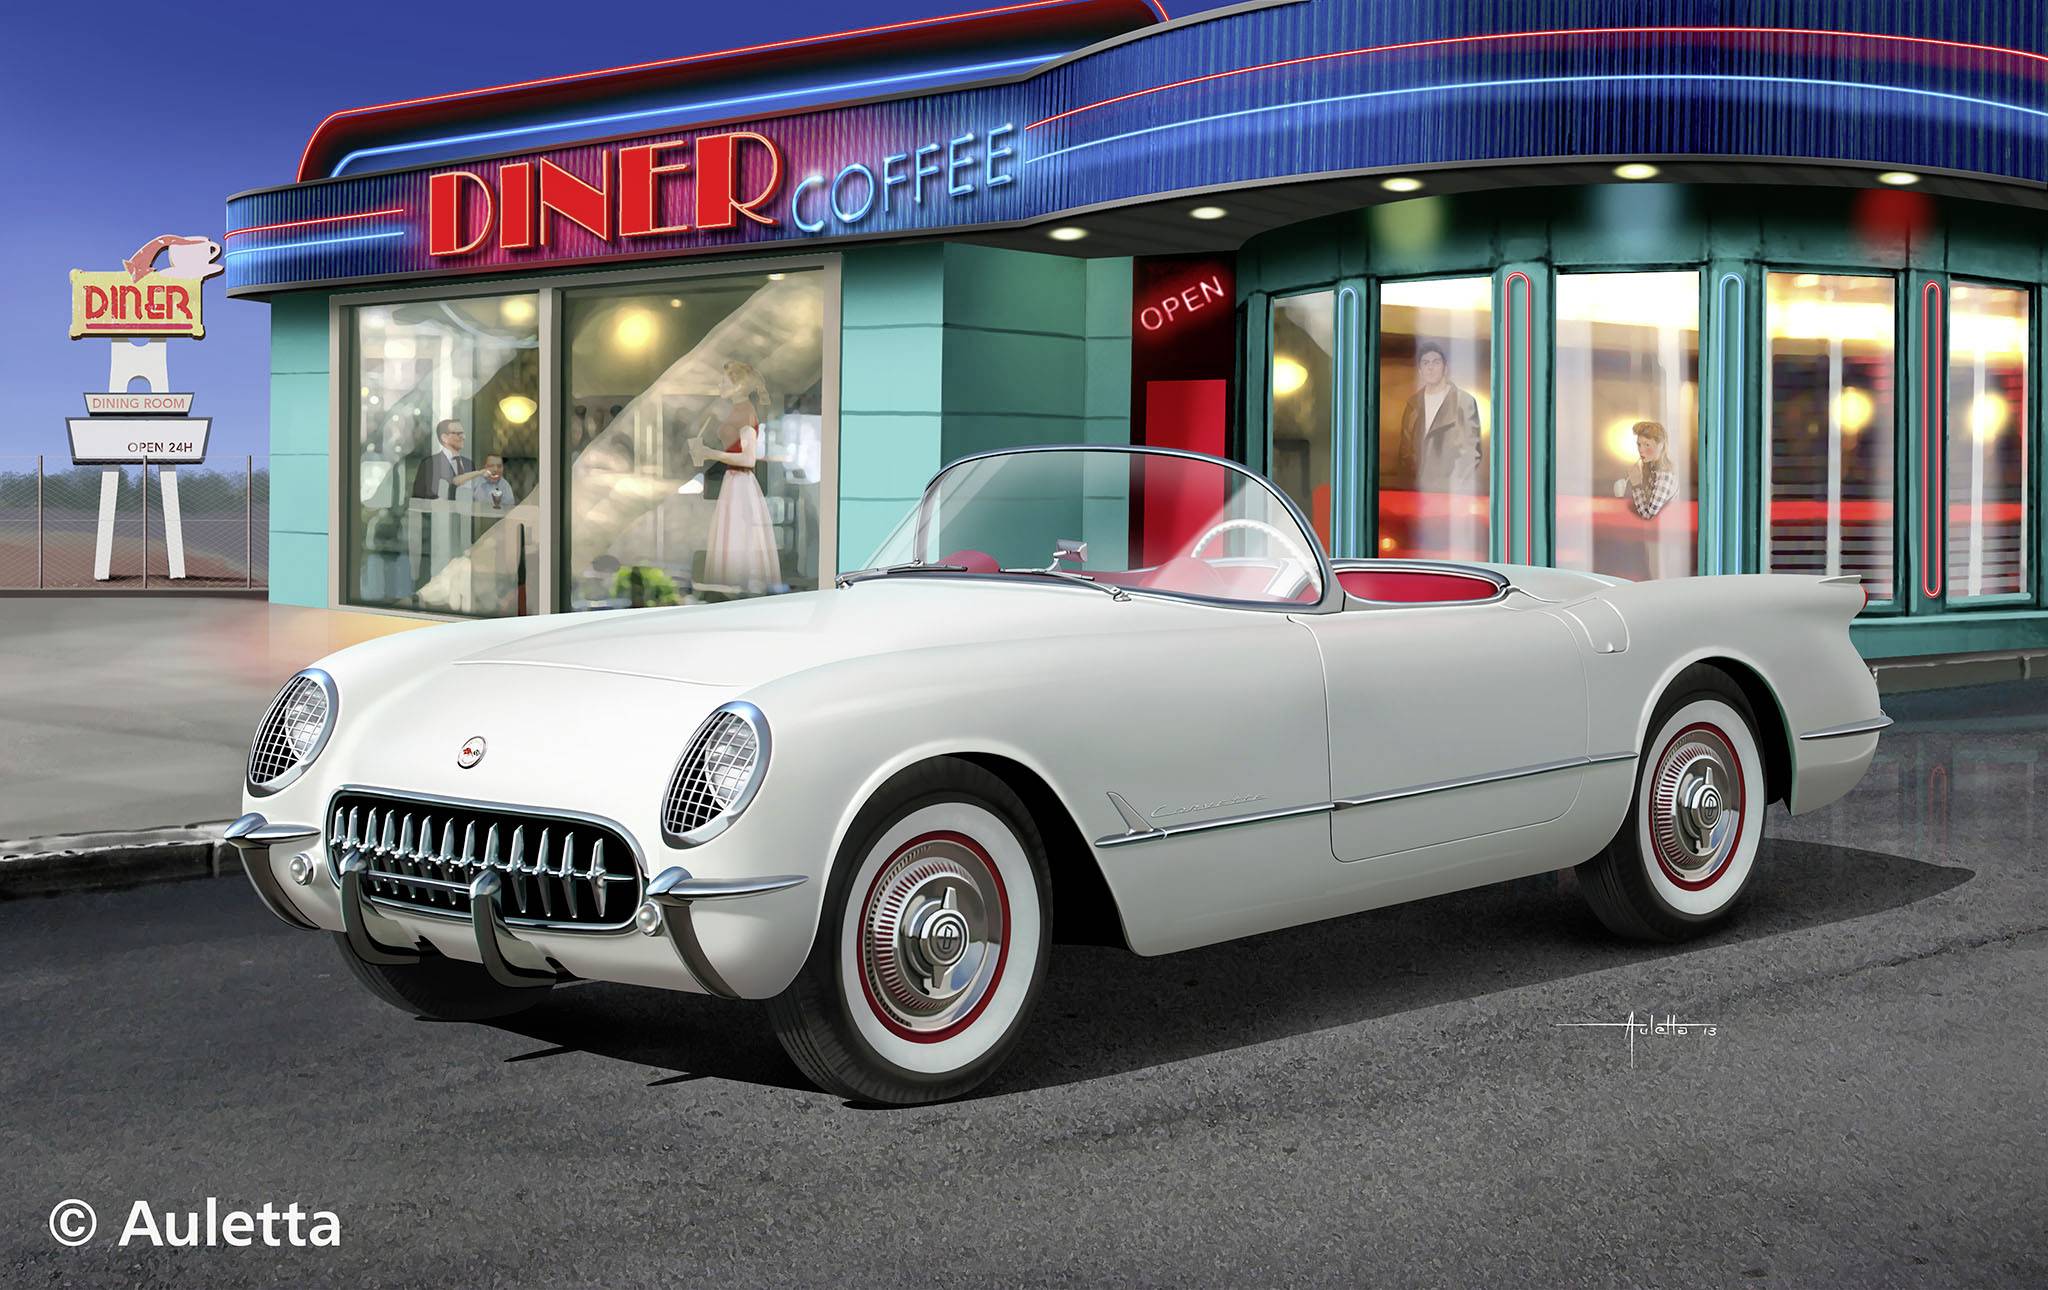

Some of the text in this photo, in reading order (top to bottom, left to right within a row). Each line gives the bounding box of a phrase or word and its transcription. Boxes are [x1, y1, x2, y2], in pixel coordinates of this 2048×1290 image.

[428, 122, 1015, 256] DINER COFFEE
[83, 285, 193, 320] DINER
[1140, 275, 1224, 331] OPEN
[92, 398, 185, 409] DINING ROOM
[128, 442, 193, 453] OPEN 24H
